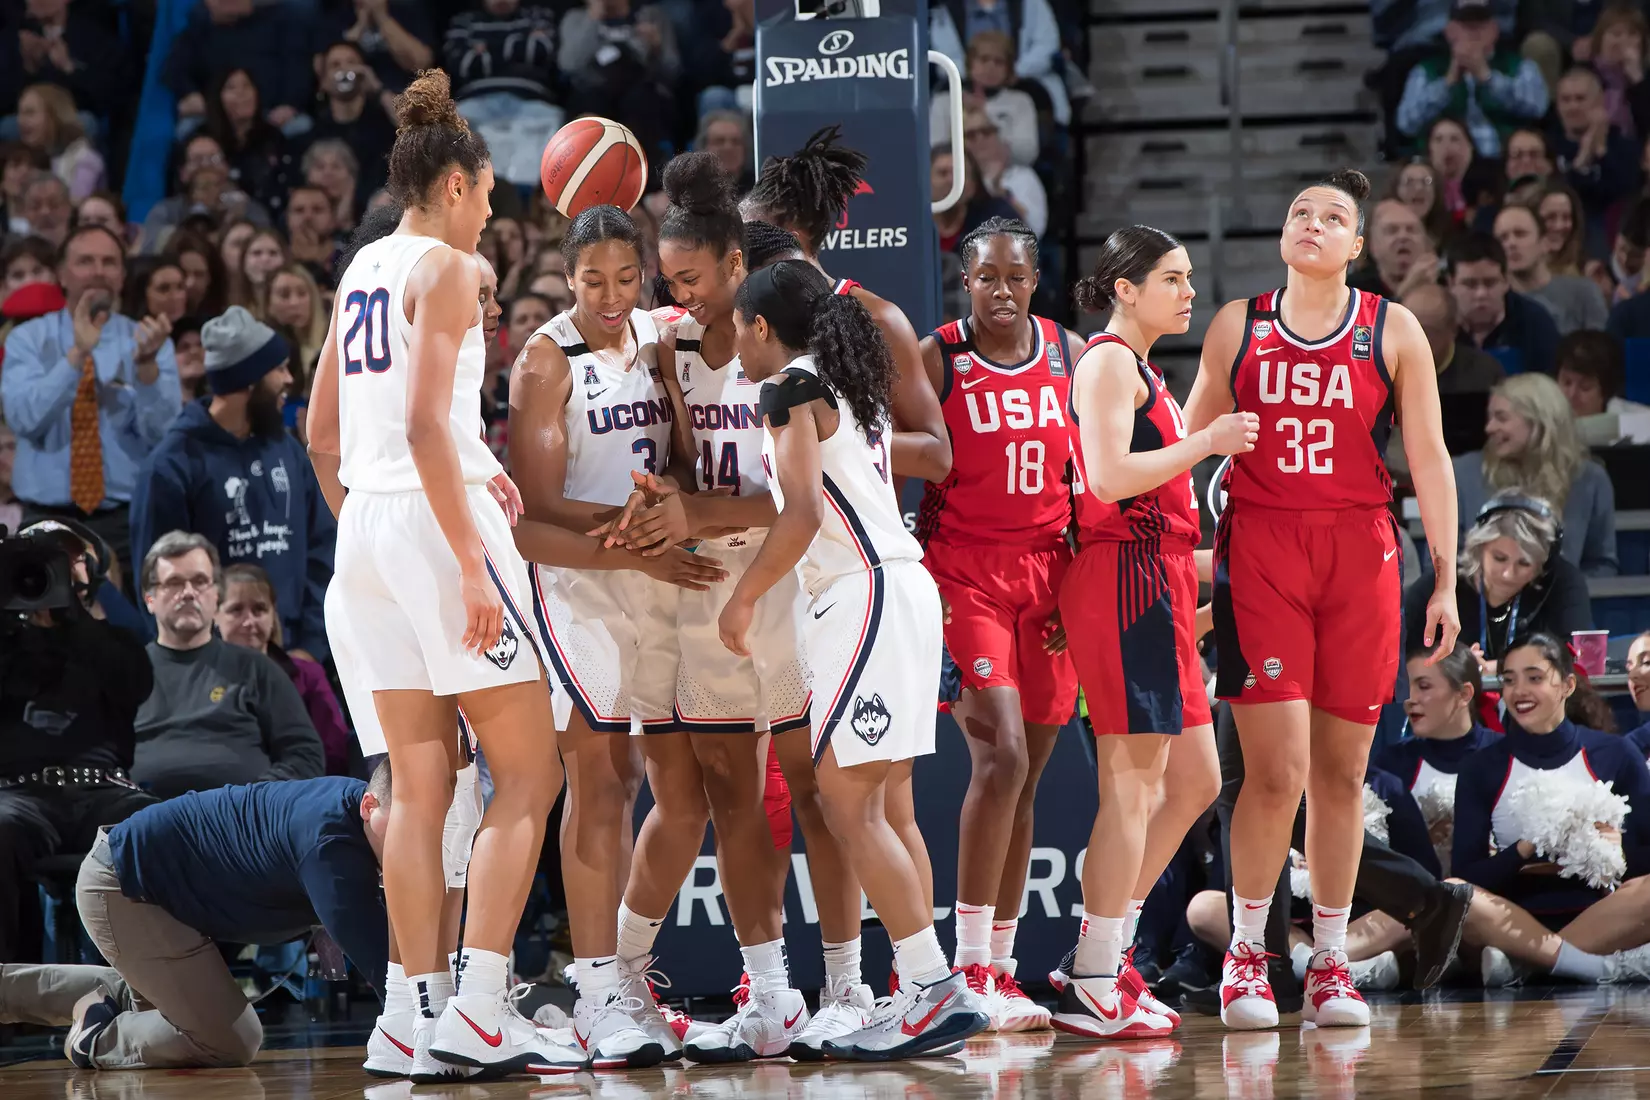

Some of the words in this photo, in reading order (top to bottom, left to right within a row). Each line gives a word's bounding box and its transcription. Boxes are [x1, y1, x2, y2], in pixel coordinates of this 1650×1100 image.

[766, 48, 909, 87] SPALDING
[548, 144, 576, 184] molten
[821, 227, 908, 250] VELERS
[343, 287, 392, 376] 20
[1258, 361, 1354, 409] USA
[687, 403, 764, 430] CONN
[964, 386, 1066, 433] USA
[631, 438, 657, 486] 3
[1005, 440, 1046, 495] 18
[1275, 417, 1335, 474] 32
